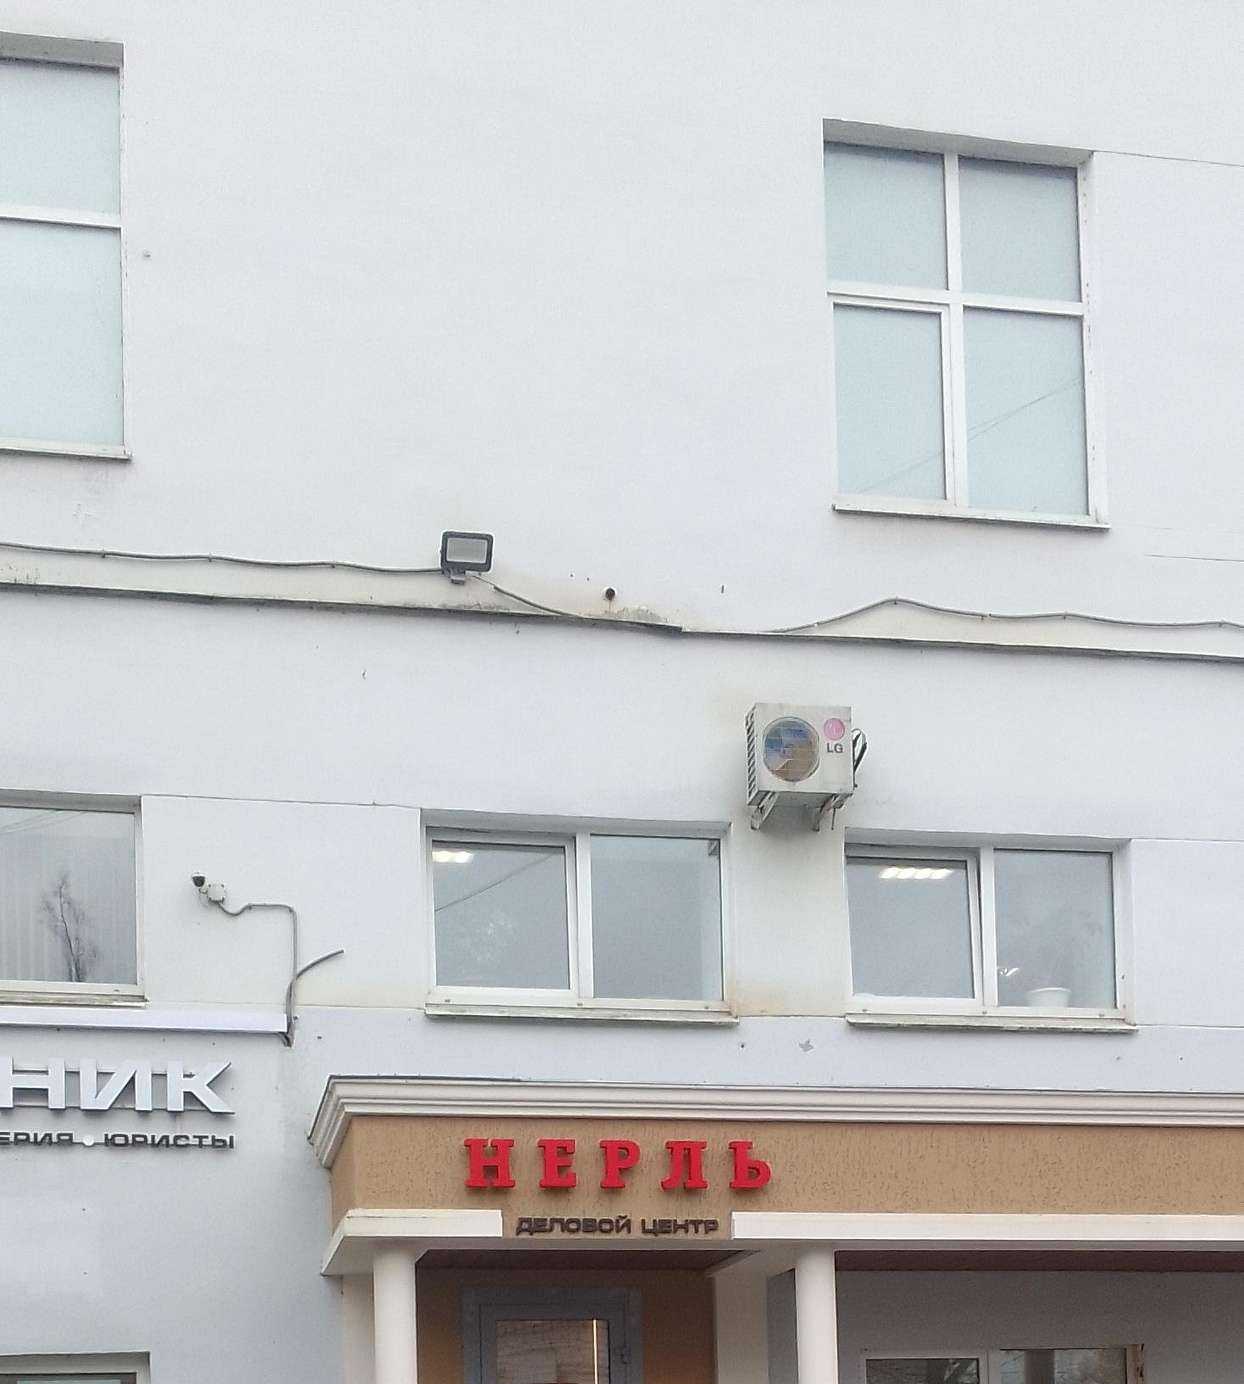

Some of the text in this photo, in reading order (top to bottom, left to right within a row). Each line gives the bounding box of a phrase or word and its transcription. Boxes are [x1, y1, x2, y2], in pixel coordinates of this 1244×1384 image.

[826, 742, 843, 753] LG
[104, 1132, 235, 1150] ЮРИСТЫ
[463, 1138, 773, 1191] НЕРЛЬ
[516, 1214, 720, 1236] ДЕЛОВОЙ ЦЕНТР
